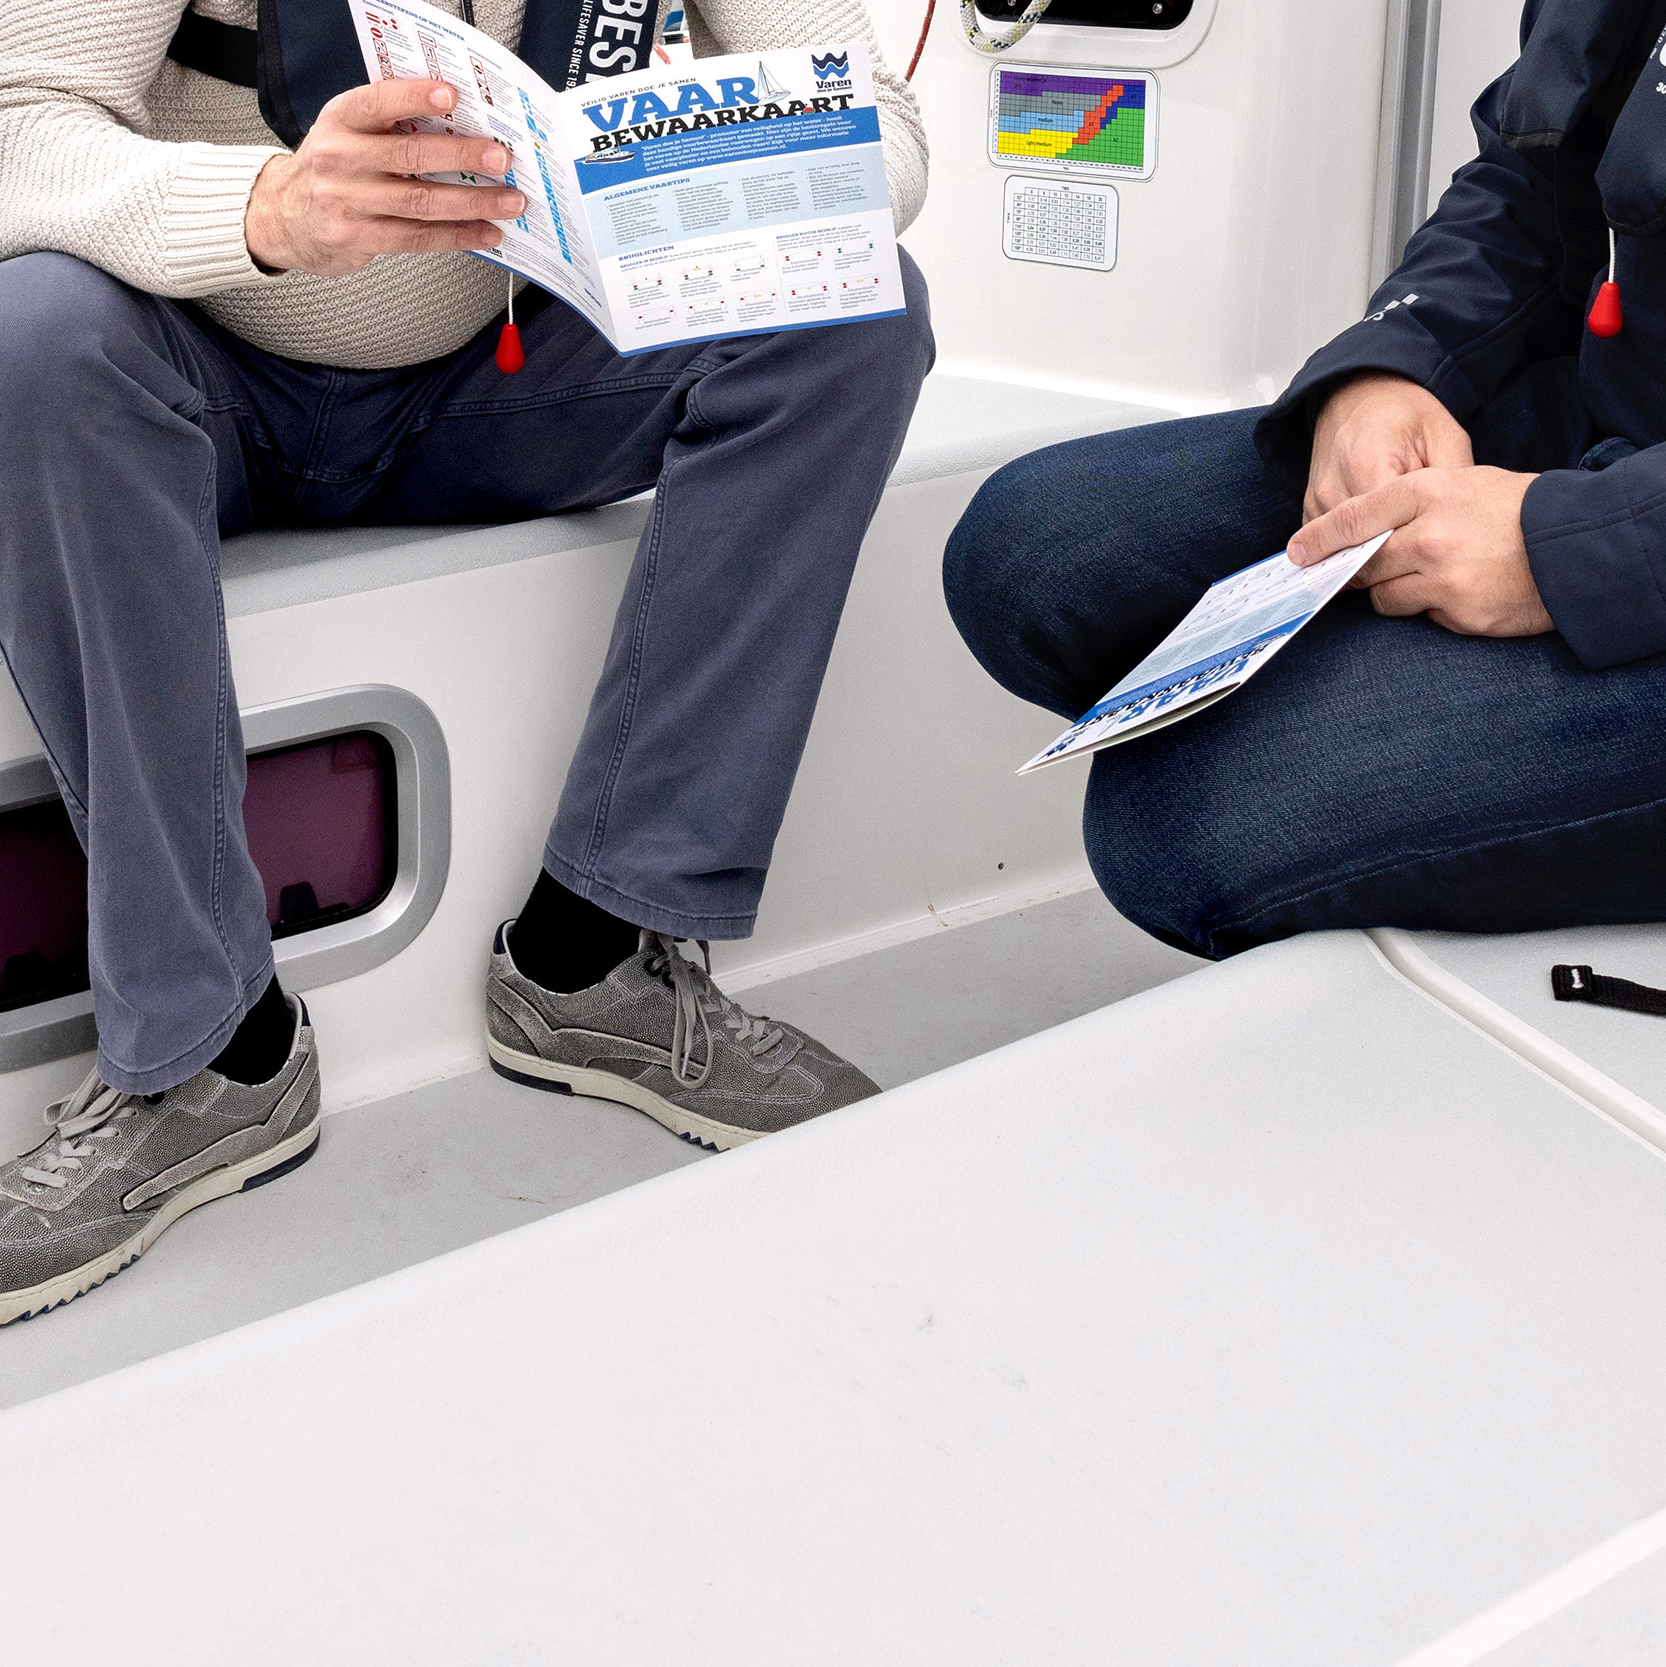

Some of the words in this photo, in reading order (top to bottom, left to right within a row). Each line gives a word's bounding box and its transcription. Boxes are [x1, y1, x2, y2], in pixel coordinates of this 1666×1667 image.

[574, 0, 594, 47] LIFESAVER
[568, 47, 583, 75] SINCE
[580, 96, 607, 107] VEILIG
[609, 89, 636, 100] VAREN
[637, 85, 655, 93] DOE
[668, 77, 697, 87] SAMEN
[815, 78, 852, 89] Varen
[582, 76, 760, 132] VAAR
[590, 94, 854, 152] BEWAARKAART
[753, 123, 783, 131] veiligheid
[657, 145, 682, 153] handige
[690, 142, 730, 152] Nederlandse
[729, 137, 765, 146] vaarwegen
[603, 185, 650, 202] ALGEMENE
[649, 177, 691, 190] VAARTIPS
[618, 245, 675, 262] BRUGLICHTEN
